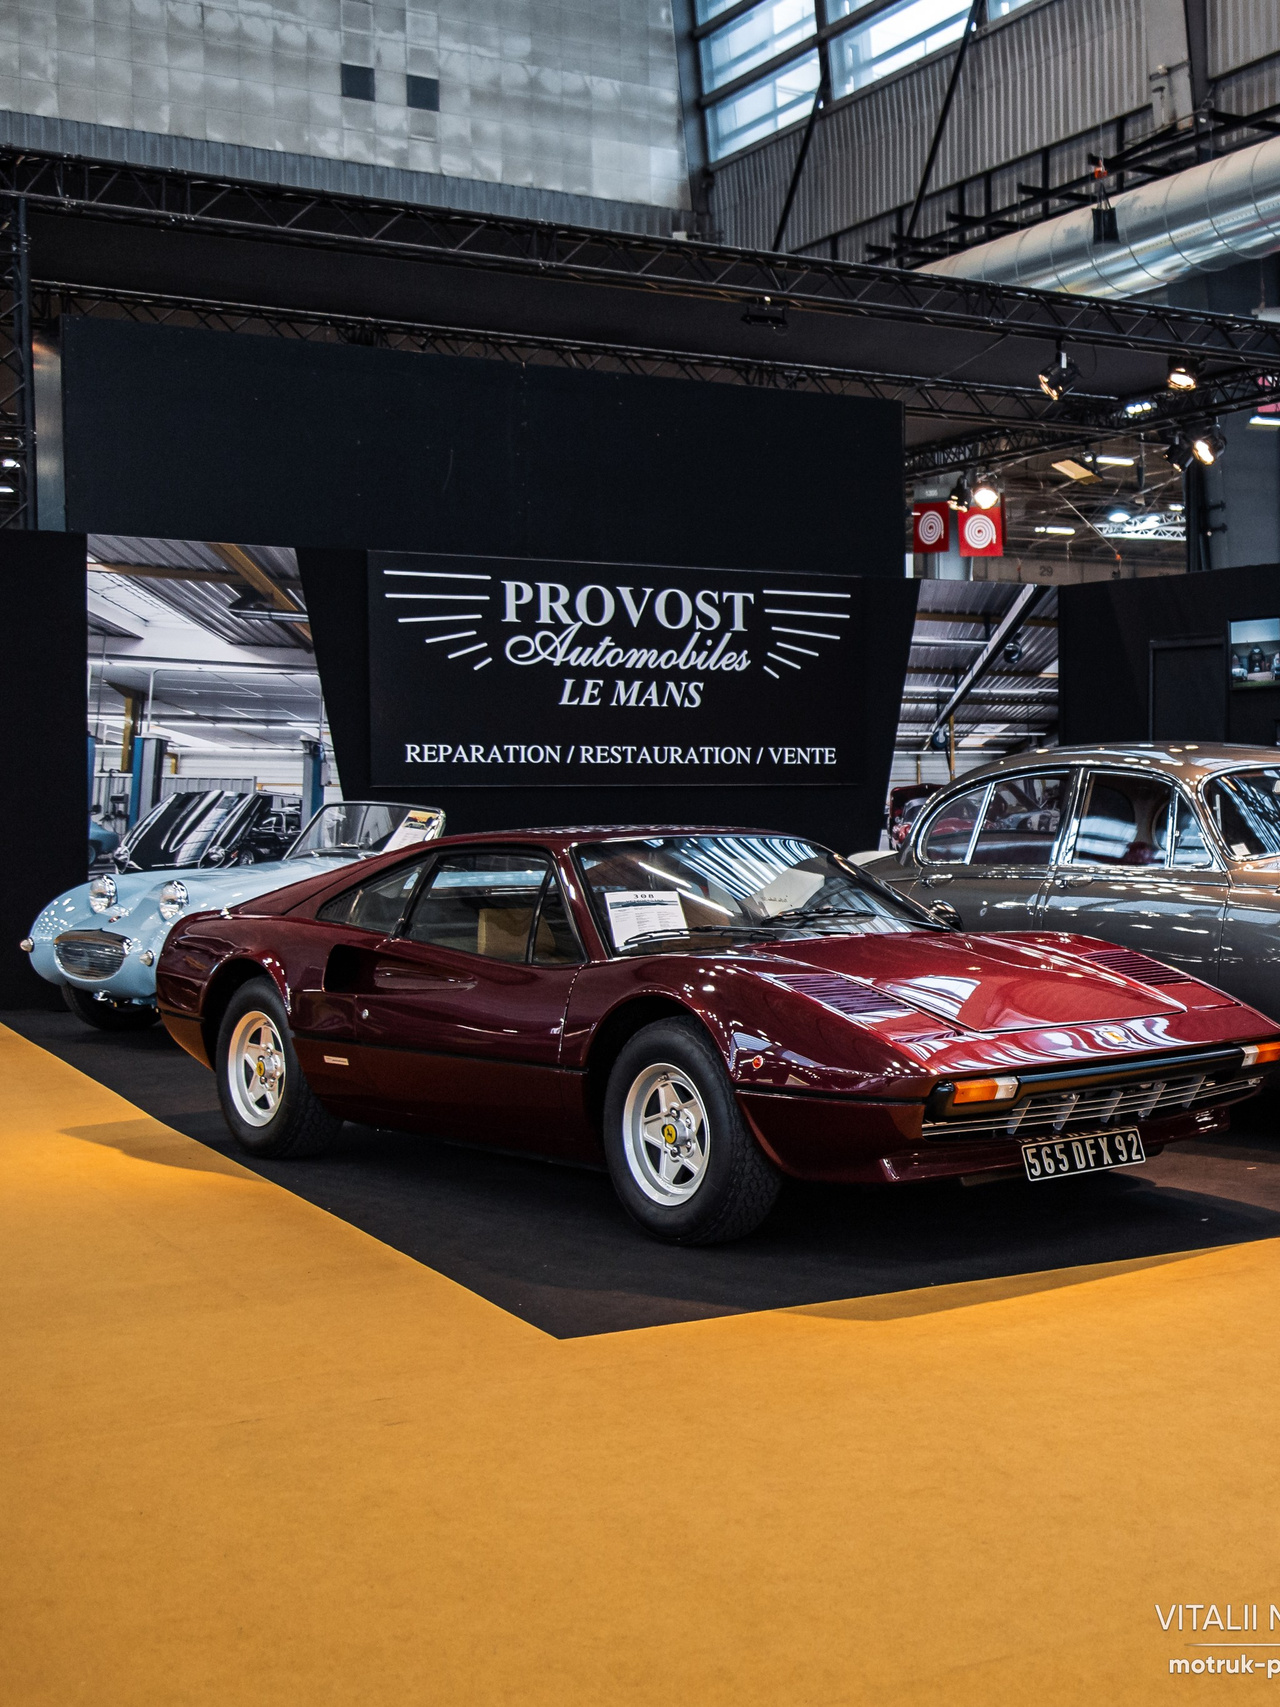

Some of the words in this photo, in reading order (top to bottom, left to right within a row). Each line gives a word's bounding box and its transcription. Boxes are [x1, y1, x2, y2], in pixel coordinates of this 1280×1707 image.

[1039, 565, 1054, 577] 29
[500, 580, 755, 633] PROVOST
[505, 621, 752, 672] Automobiles
[558, 679, 603, 706] LE
[609, 680, 705, 708] MANS
[404, 743, 563, 764] REPARATION
[579, 745, 753, 765] RESTAURATION
[768, 747, 838, 765] VENTE
[1026, 1143, 1070, 1177] 565
[1071, 1136, 1114, 1170] DFX
[1114, 1133, 1142, 1162] 92
